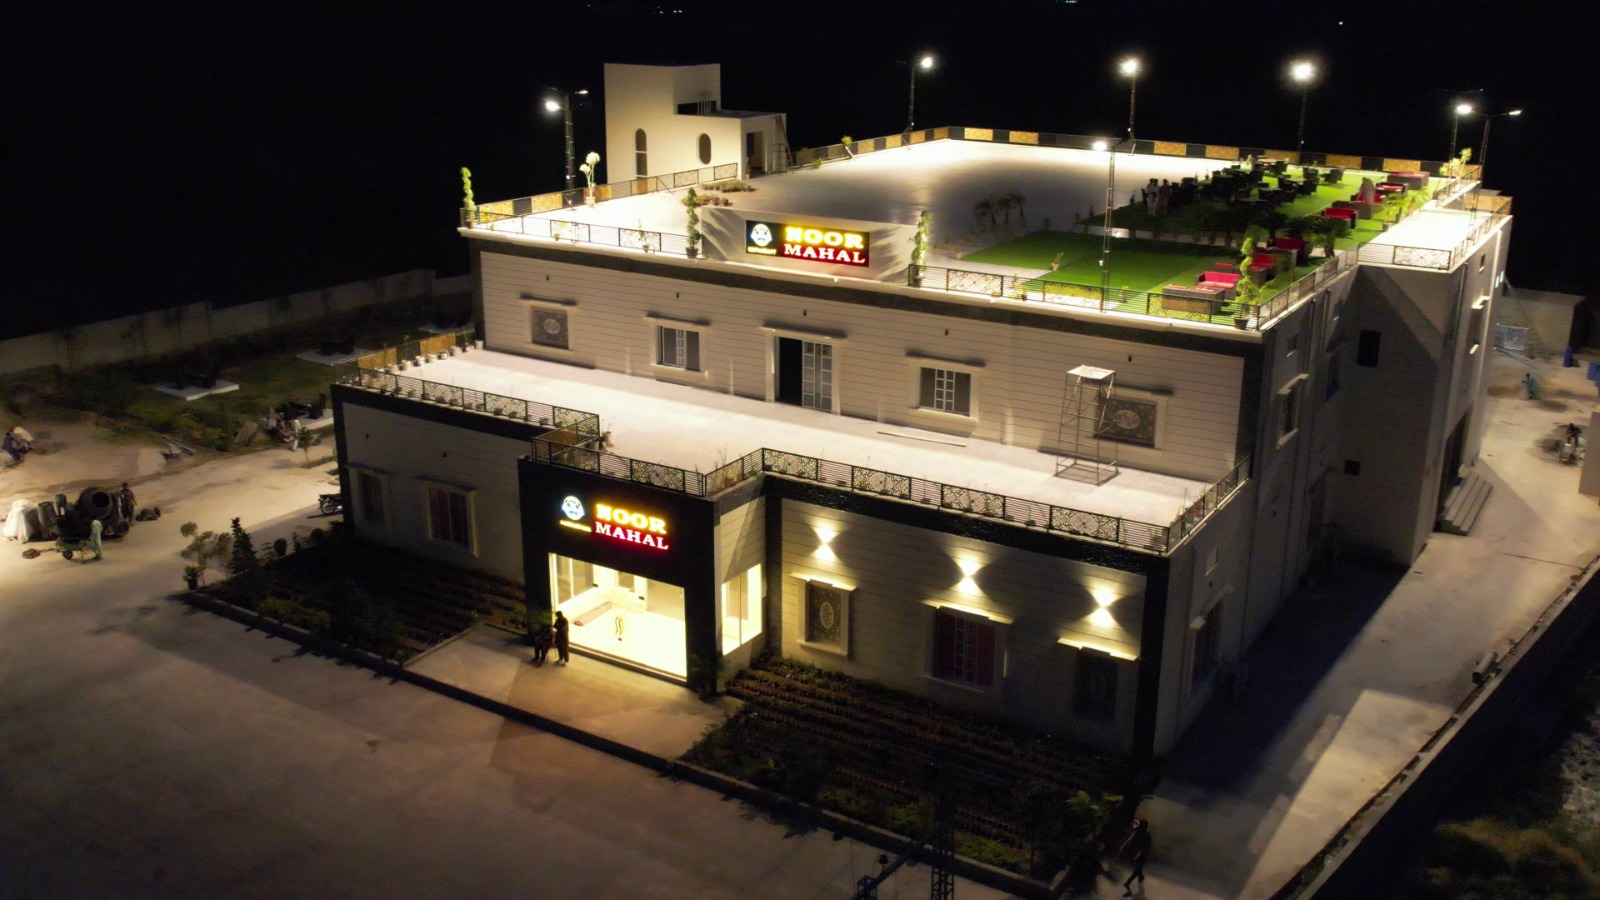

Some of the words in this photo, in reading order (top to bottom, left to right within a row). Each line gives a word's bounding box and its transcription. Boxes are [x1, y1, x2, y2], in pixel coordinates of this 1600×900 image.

[785, 227, 864, 249] NOOR
[784, 244, 866, 264] MAHAL
[596, 503, 667, 534] NOOR
[596, 522, 668, 549] MAHAL
